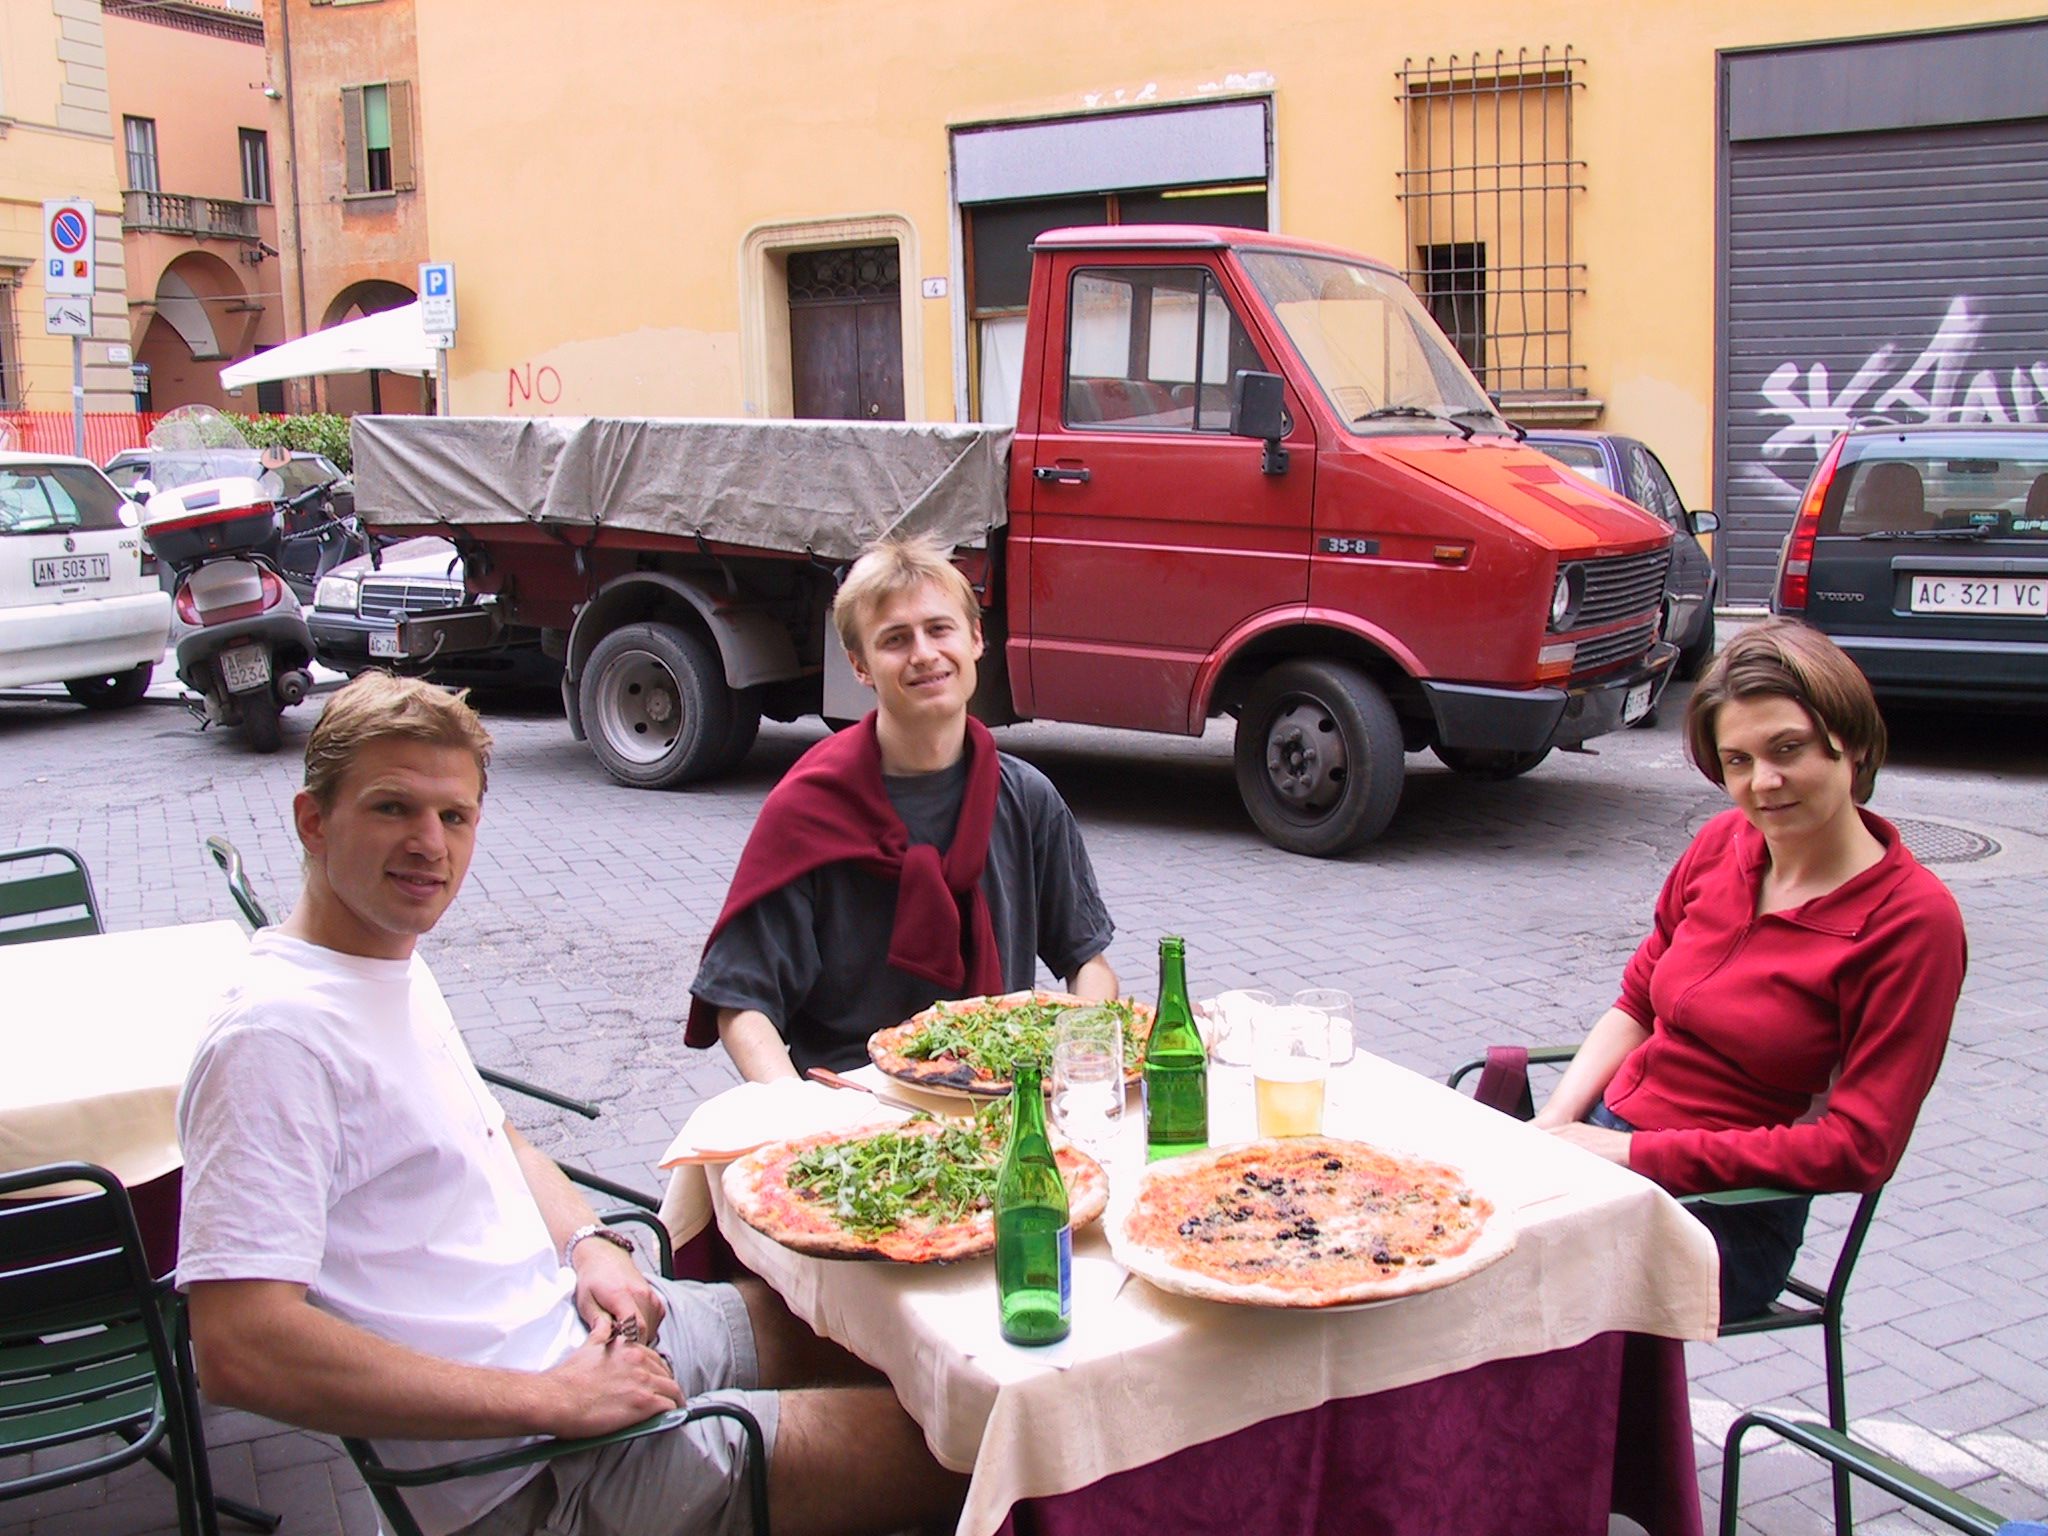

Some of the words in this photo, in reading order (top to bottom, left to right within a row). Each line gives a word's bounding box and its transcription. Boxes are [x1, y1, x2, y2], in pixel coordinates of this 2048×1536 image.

[52, 261, 62, 275] P
[430, 272, 444, 293] P
[508, 362, 562, 408] NO
[1328, 538, 1366, 554] 35-8
[39, 562, 56, 581] AN
[62, 559, 87, 579] 503
[91, 558, 106, 576] TY
[1919, 583, 1946, 604] AC
[1961, 583, 1999, 606] 321
[2014, 584, 2041, 607] VC
